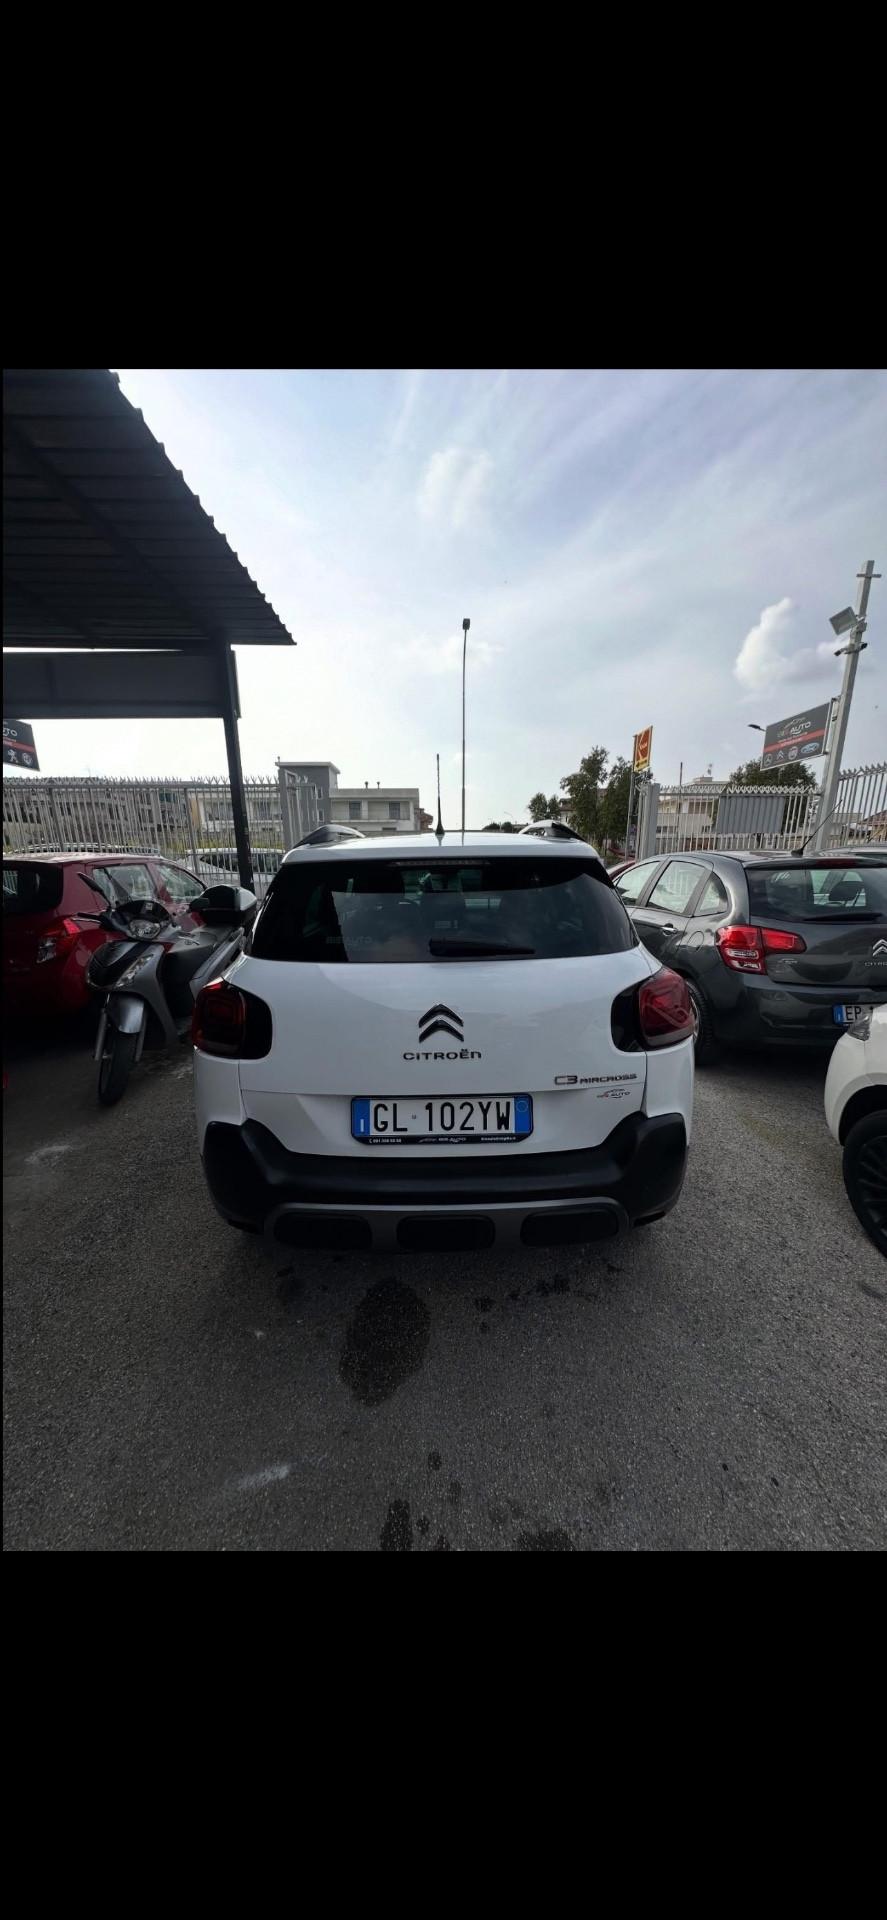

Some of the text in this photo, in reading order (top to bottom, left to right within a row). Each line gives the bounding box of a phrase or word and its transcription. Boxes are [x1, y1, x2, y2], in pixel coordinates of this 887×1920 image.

[790, 721, 811, 733] AUTO
[845, 1006, 862, 1021] EP
[555, 1073, 638, 1085] C3 AIRCROSS
[373, 1103, 408, 1132] GL
[425, 1101, 511, 1131] 102YW
